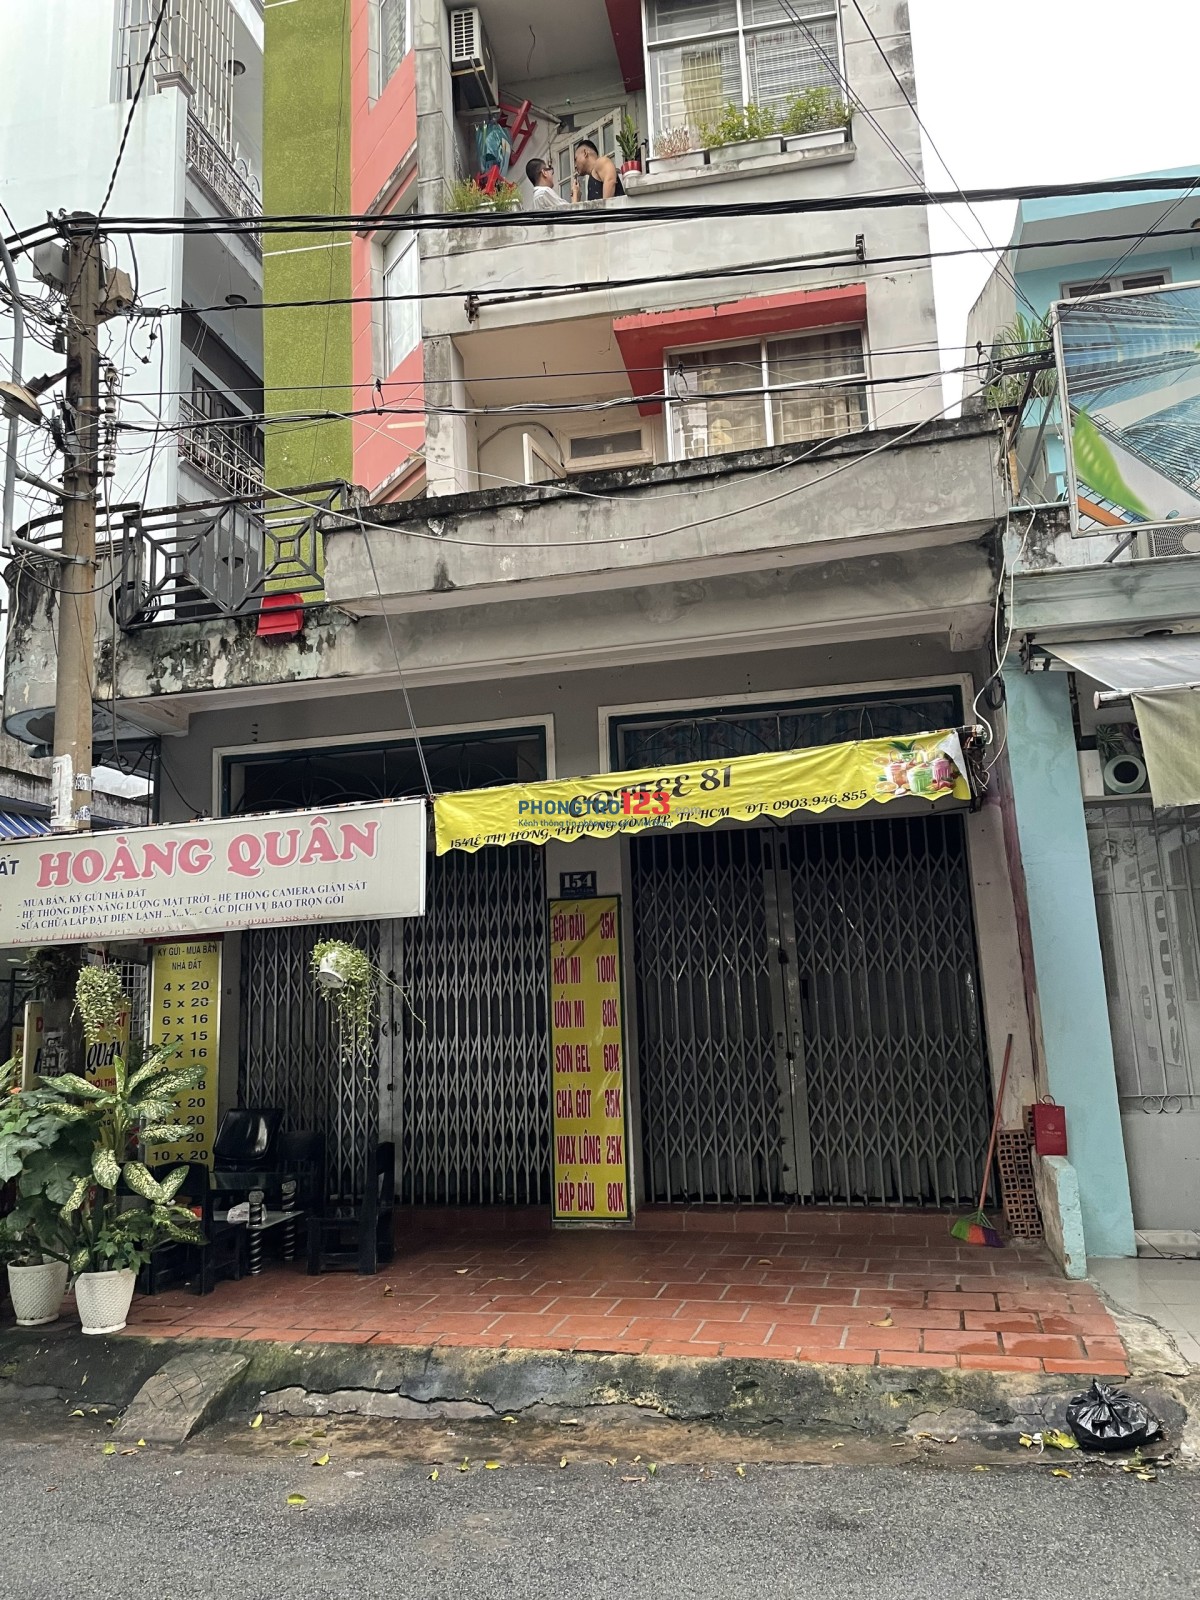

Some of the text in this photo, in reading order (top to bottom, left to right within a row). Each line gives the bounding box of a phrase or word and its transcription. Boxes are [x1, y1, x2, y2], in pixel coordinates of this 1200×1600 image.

[699, 764, 732, 791] 81
[484, 833, 506, 844] THỊ
[772, 789, 867, 811] 0903.946.855
[36, 815, 379, 888] HOÀNG QUÂN
[564, 873, 592, 888] 154
[22, 909, 35, 921] HỆ
[37, 905, 70, 917] THỐNG
[126, 899, 160, 911] LƯỢNG
[187, 893, 210, 905] TRỜI
[218, 892, 232, 903] HỆ
[234, 887, 270, 900] THỐNG
[272, 886, 316, 898] CAMERA
[317, 882, 346, 894] GIÁM
[348, 880, 368, 891] SÁT
[23, 899, 44, 907] MUA
[104, 888, 124, 900] NHÀ
[136, 911, 162, 922] LẠNH
[204, 903, 226, 914] CÁC
[227, 902, 252, 915] DỊCH
[255, 901, 268, 912] VỤ
[271, 899, 293, 910] BAO
[295, 896, 323, 908] TRỌN
[325, 894, 344, 905] GÓI
[569, 904, 586, 941] ĐẦU
[600, 912, 616, 940] 35K
[186, 945, 201, 955] MUA
[171, 957, 202, 970] NHÀ ĐẤT
[553, 948, 617, 985] NỐI MI 100K
[163, 980, 210, 992] 4 x 20
[162, 997, 209, 1009] 5 x 20
[554, 990, 618, 1029] UỐN MI 80K
[162, 1013, 208, 1026] 6 x 16
[161, 1030, 208, 1042] 7 x 15
[189, 1047, 207, 1058] 16
[575, 1044, 591, 1073] GEL
[603, 1043, 620, 1072] 60K
[191, 1080, 206, 1090] 8
[187, 1097, 206, 1108] 20
[556, 1083, 621, 1119] CHÀ GÓT 35K
[186, 1115, 205, 1126] 20
[186, 1132, 204, 1143] 20
[152, 1150, 208, 1161] 10 x 20
[556, 1129, 623, 1165] WAX LÔNG 25K
[557, 1171, 625, 1212] HẤP DẦU 80K
